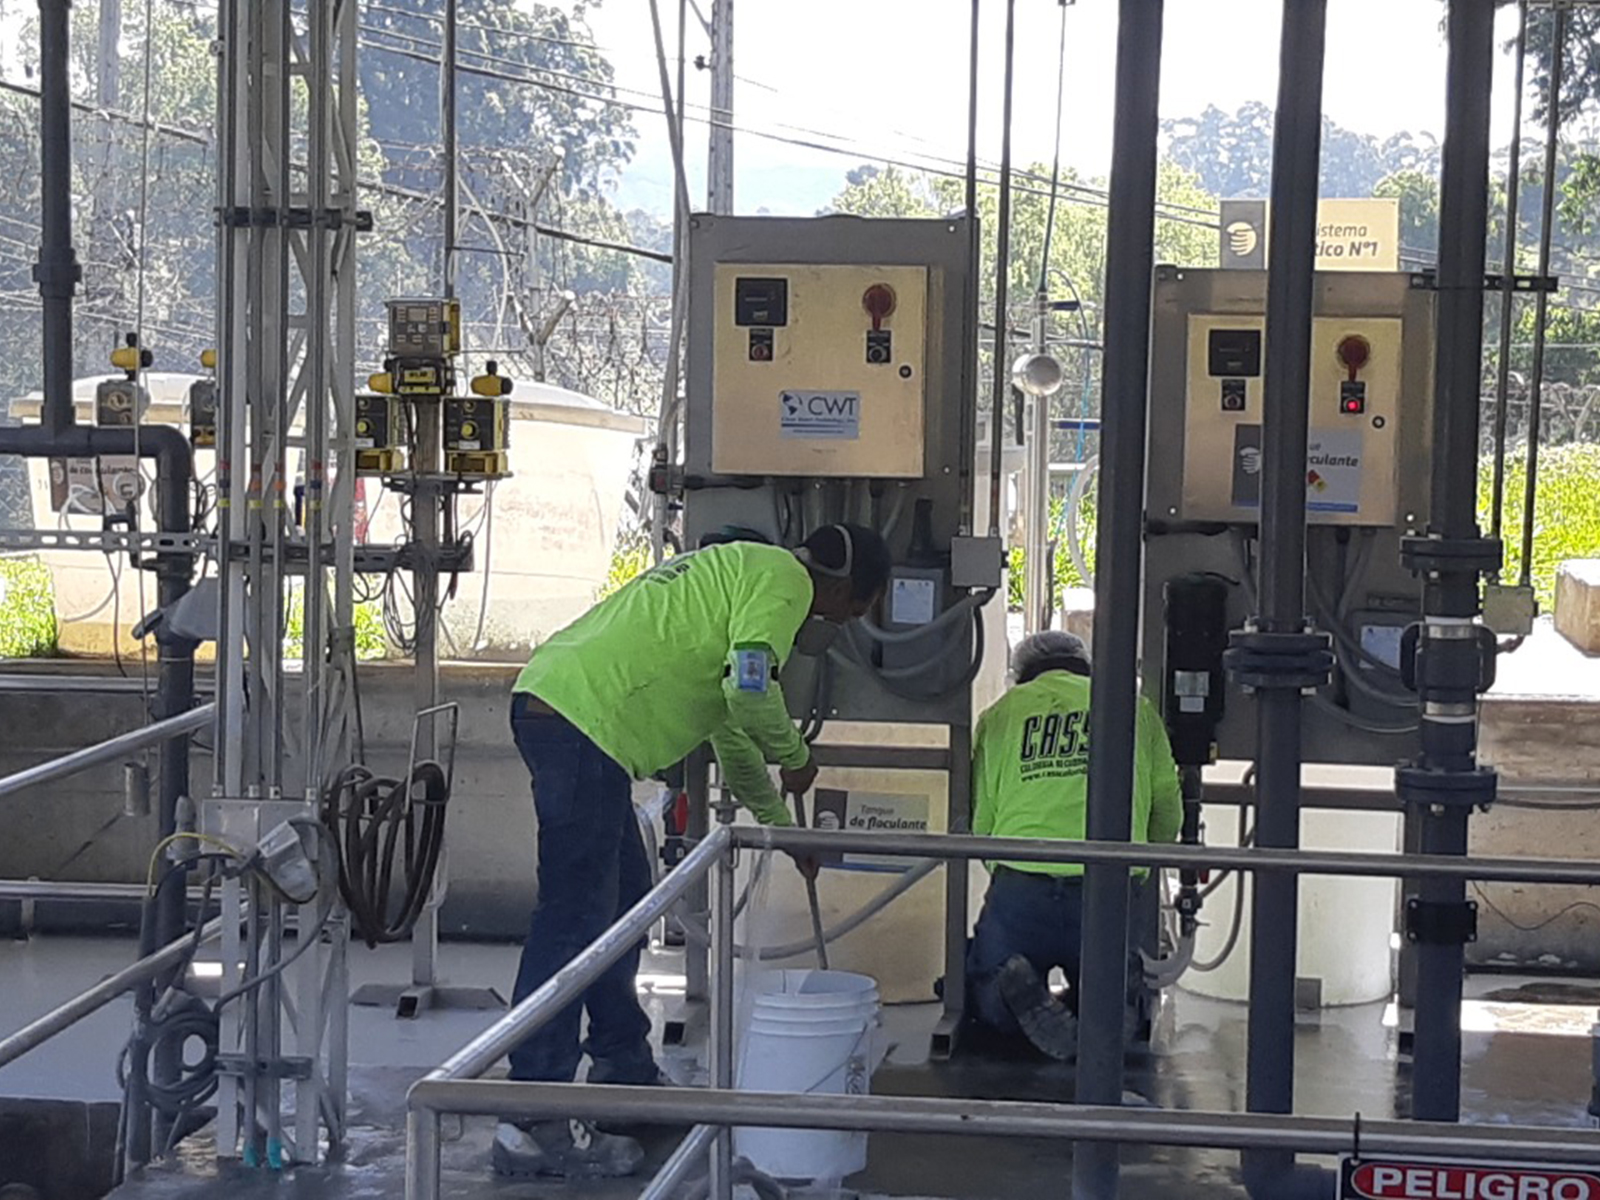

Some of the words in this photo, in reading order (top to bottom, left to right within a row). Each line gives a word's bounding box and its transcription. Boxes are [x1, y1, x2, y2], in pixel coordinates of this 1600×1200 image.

[1316, 223, 1367, 237] istema
[807, 396, 857, 416] CWT
[1309, 454, 1359, 467] culante
[849, 816, 866, 826] de
[866, 816, 928, 830] floculante
[1372, 1166, 1591, 1200] PELIGRO
